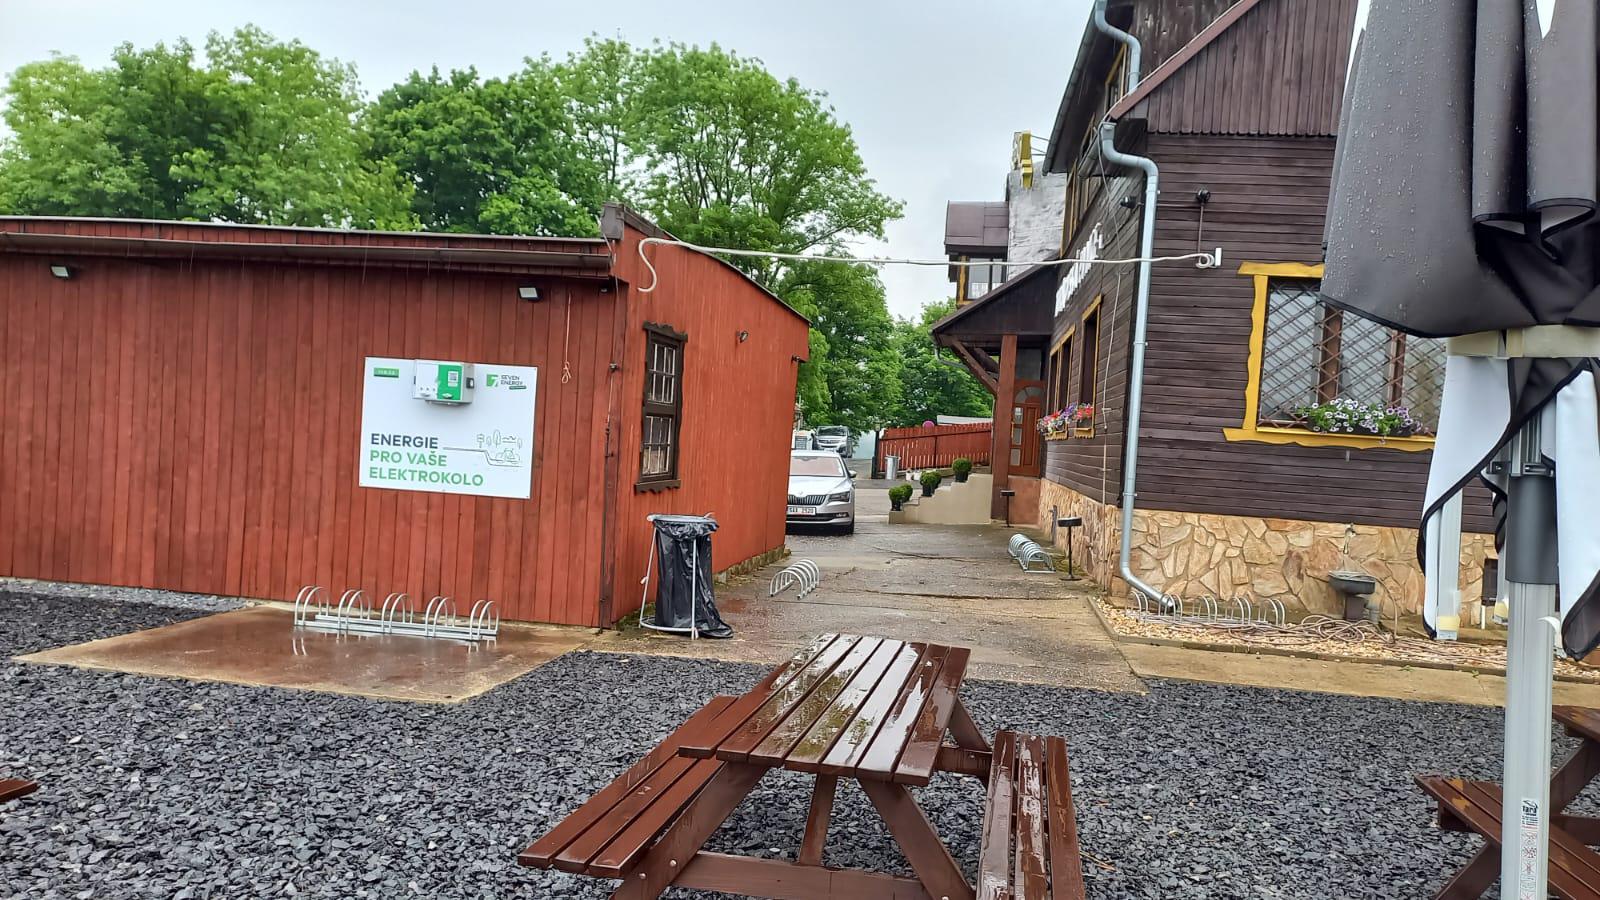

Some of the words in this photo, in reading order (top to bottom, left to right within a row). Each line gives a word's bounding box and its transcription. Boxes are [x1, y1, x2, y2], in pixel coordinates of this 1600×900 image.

[371, 433, 439, 449] ENERGIE
[370, 449, 402, 464] PRO
[407, 450, 447, 467] VAŠE
[369, 466, 484, 487] ELEKTROKOLO
